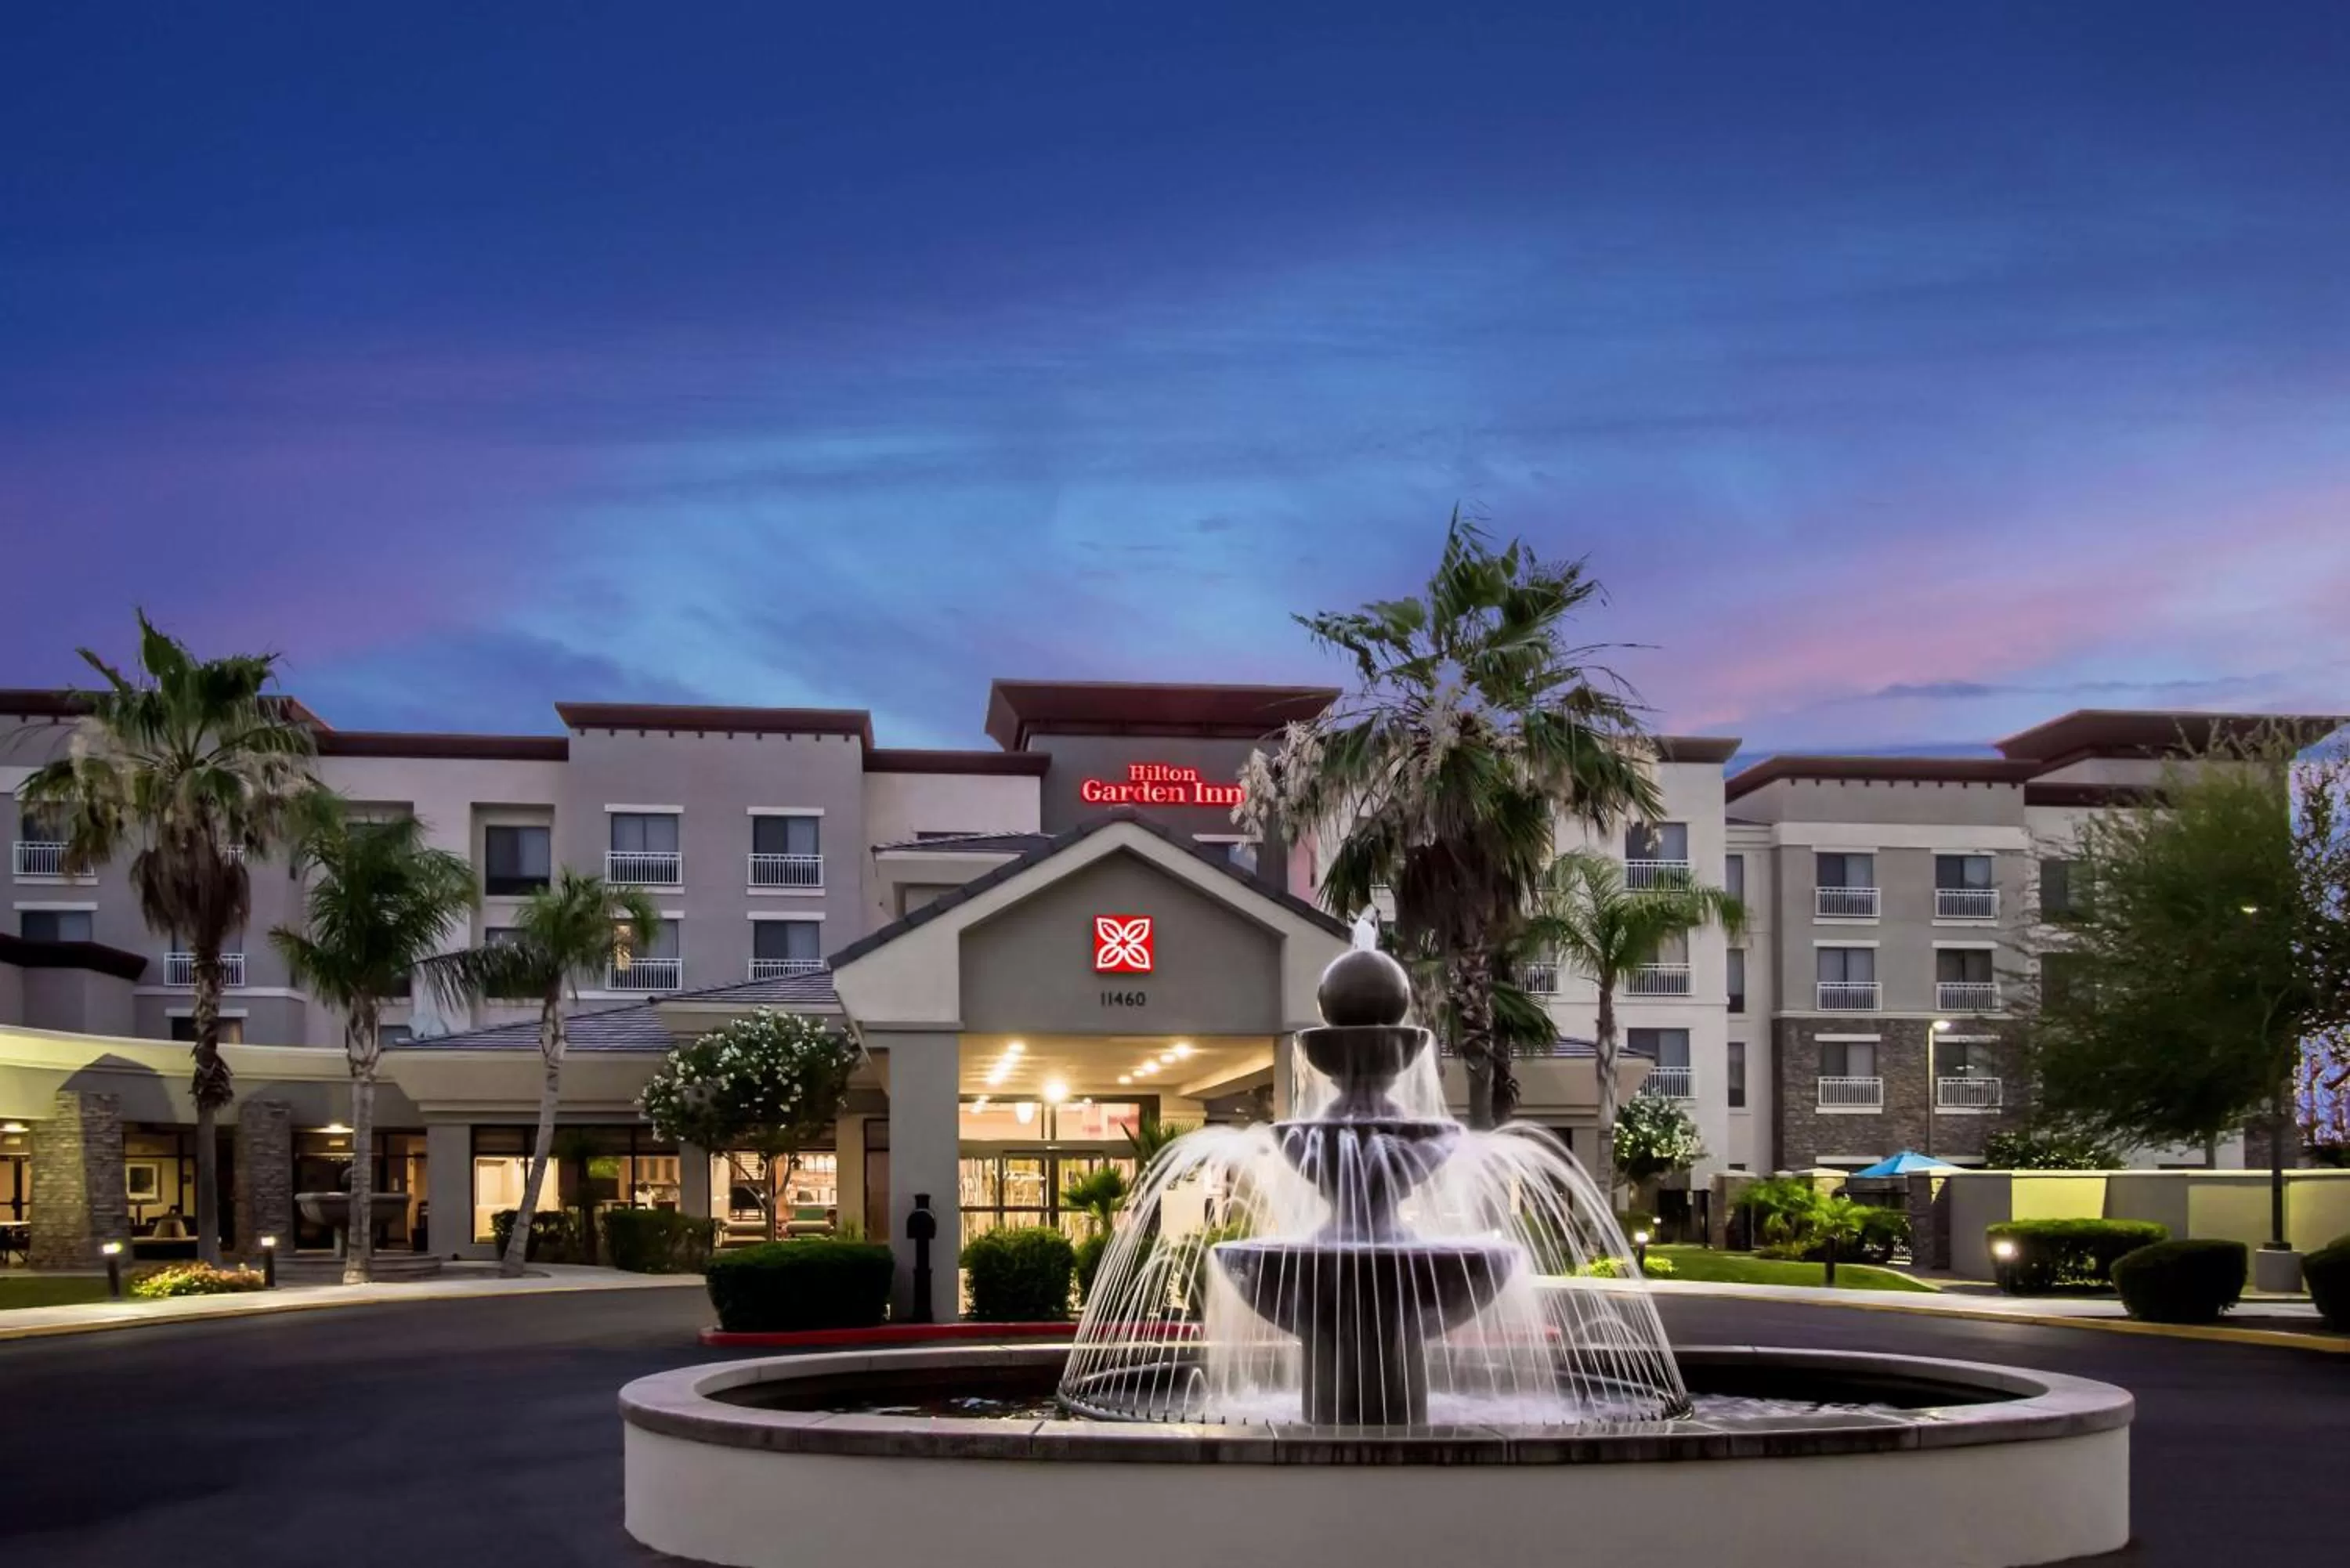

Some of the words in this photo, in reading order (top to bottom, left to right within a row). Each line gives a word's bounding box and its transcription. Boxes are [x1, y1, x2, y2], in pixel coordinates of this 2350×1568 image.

[1129, 764, 1197, 782] Hilton
[1082, 780, 1185, 803] Garden
[1194, 782, 1244, 804] Inn
[1101, 991, 1146, 1006] 11460
